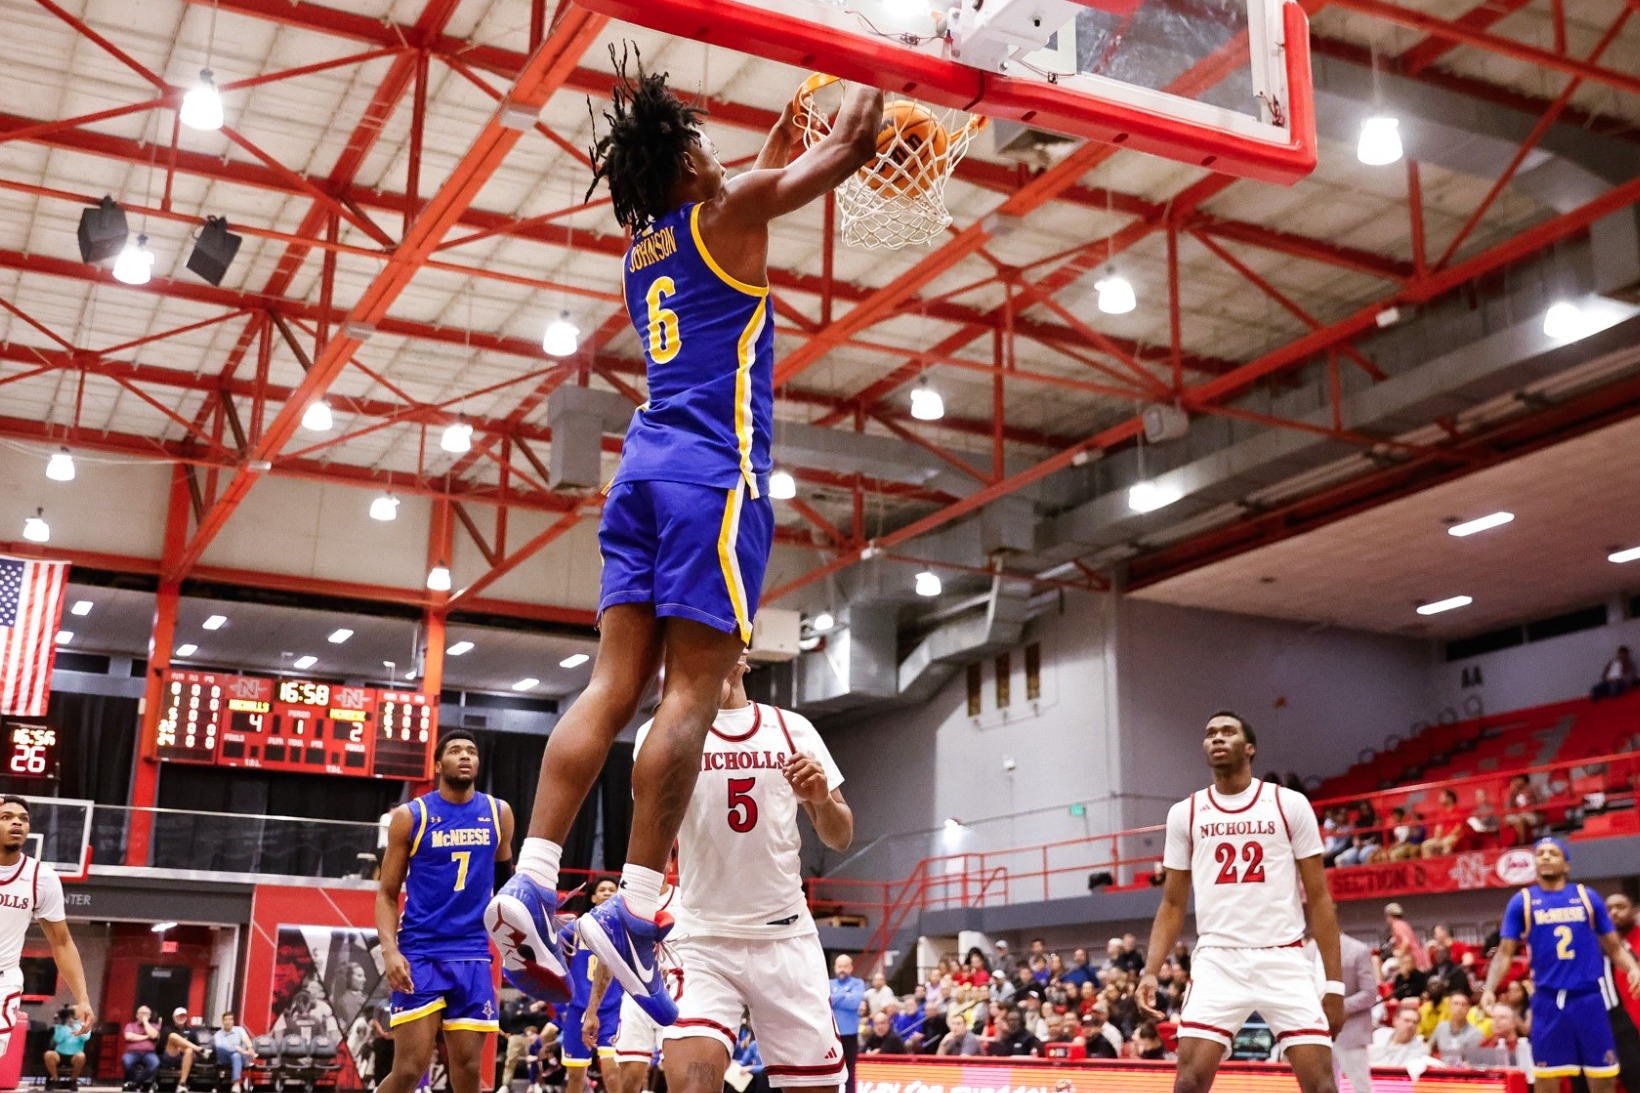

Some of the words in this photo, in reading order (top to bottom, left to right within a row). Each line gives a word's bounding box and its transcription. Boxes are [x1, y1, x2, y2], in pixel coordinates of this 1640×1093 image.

[629, 226, 677, 273] JOHNSON
[646, 276, 682, 364] 6
[174, 695, 180, 707] 1
[280, 682, 330, 706] 16:58
[212, 712, 218, 723] 1
[249, 714, 262, 732] 4
[297, 719, 304, 734] 1
[350, 722, 363, 742] 2
[11, 744, 46, 773] 26
[700, 751, 785, 771] ICHOLLS
[727, 777, 758, 833] 5
[432, 828, 491, 848] McNEESE
[1200, 821, 1276, 838] NICHOLLS
[451, 851, 471, 892] 7
[1214, 841, 1265, 884] 22
[1553, 925, 1576, 960] 2
